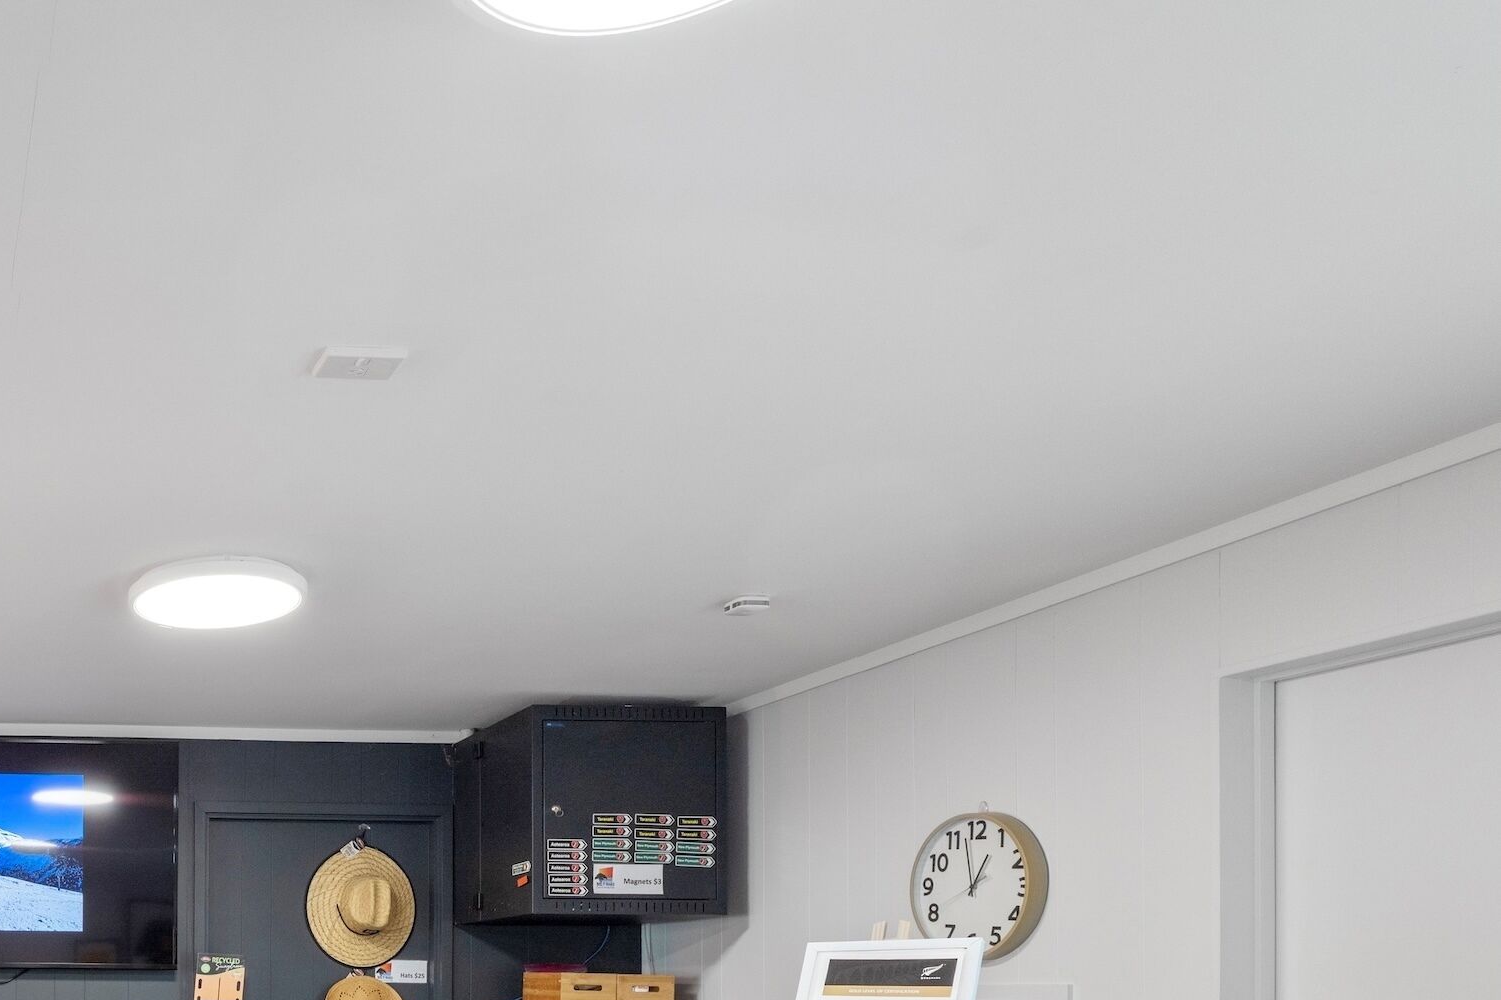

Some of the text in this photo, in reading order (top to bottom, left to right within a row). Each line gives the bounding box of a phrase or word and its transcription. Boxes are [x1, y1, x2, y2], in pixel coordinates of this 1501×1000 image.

[967, 820, 987, 840] 12
[998, 828, 1005, 847] 1
[946, 831, 960, 850] 11
[930, 853, 949, 872] 10
[1012, 849, 1024, 869] 2
[624, 878, 652, 886] Magnets
[923, 877, 934, 896] 9
[928, 903, 939, 922] 8
[1008, 905, 1020, 920] 4
[945, 924, 956, 938] 7
[989, 926, 1002, 946] 5
[211, 956, 240, 964] RECYCLED
